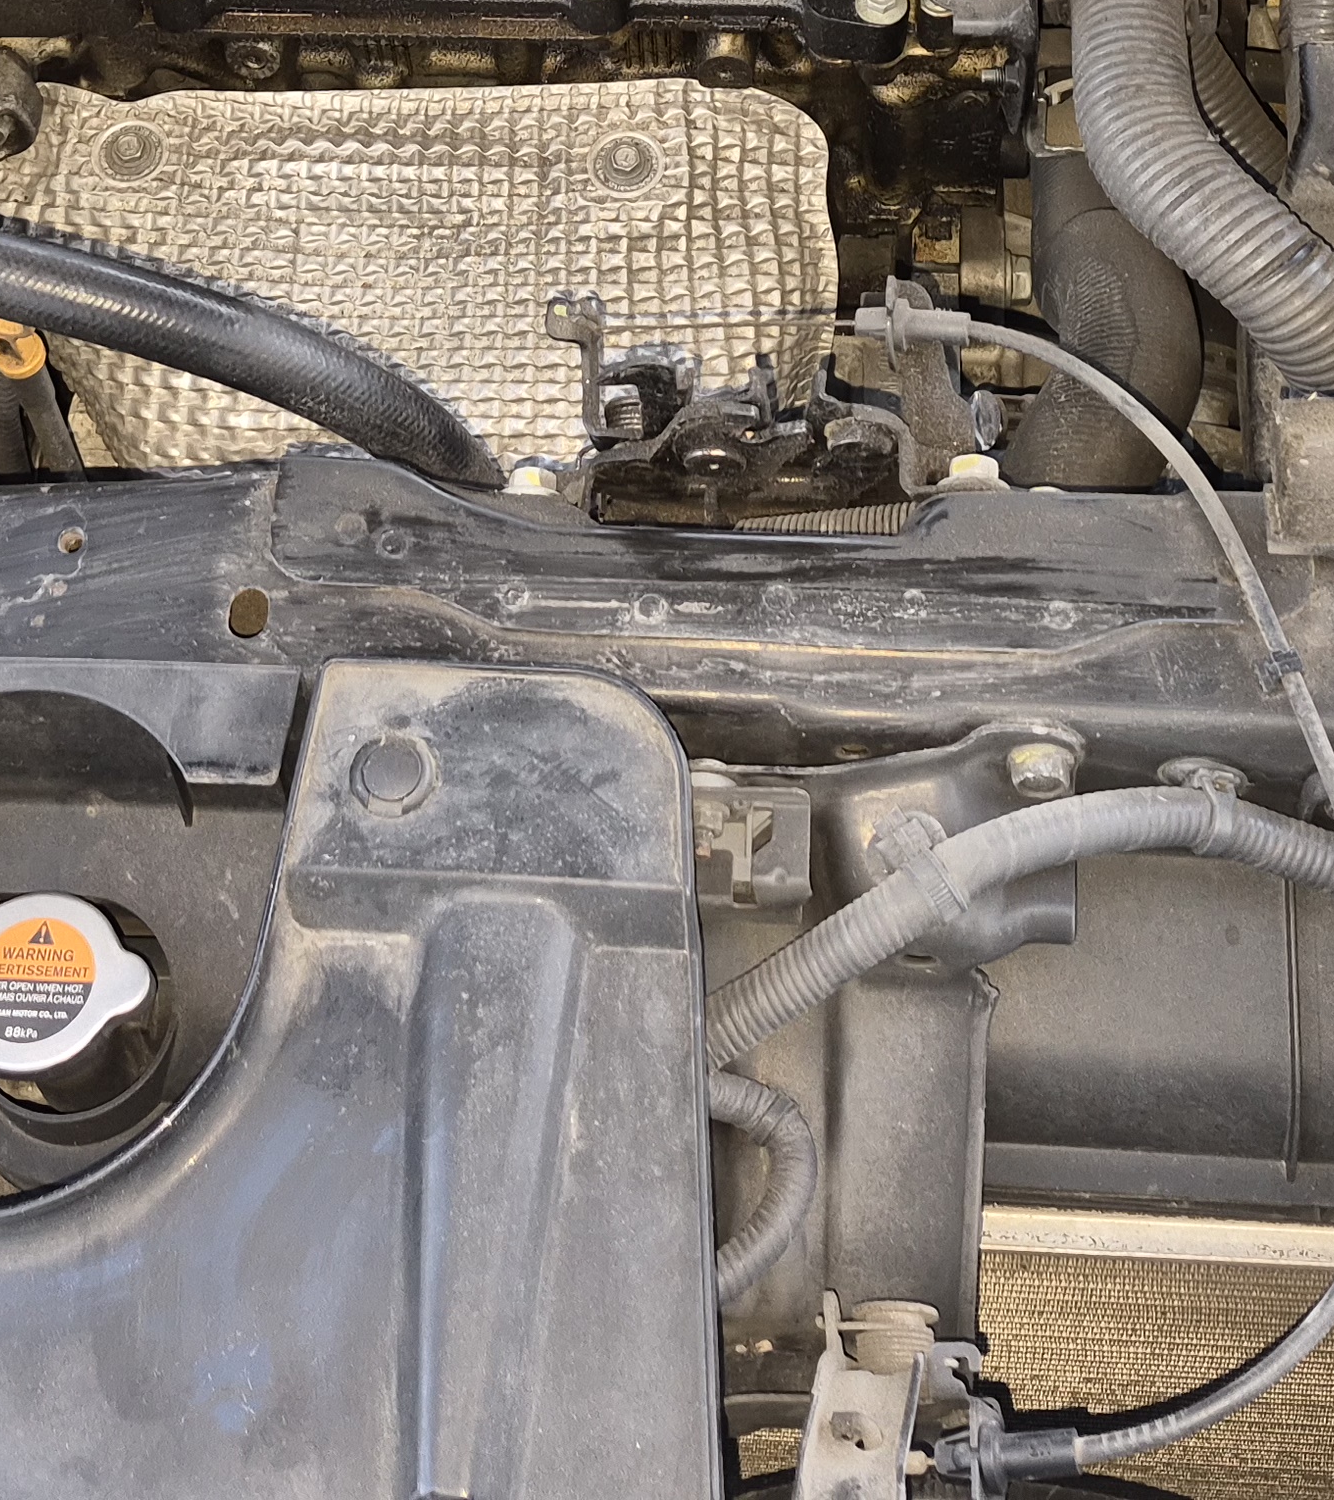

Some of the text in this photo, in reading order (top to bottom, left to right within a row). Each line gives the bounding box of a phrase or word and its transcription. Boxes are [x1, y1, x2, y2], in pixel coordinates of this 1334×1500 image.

[2, 945, 75, 963] WARNING
[8, 982, 34, 992] OPEN
[35, 983, 63, 994] WHEN
[15, 993, 47, 1004] OUVRIR
[11, 1009, 38, 1018] MOTOR
[4, 1026, 38, 1039] 88kPa
